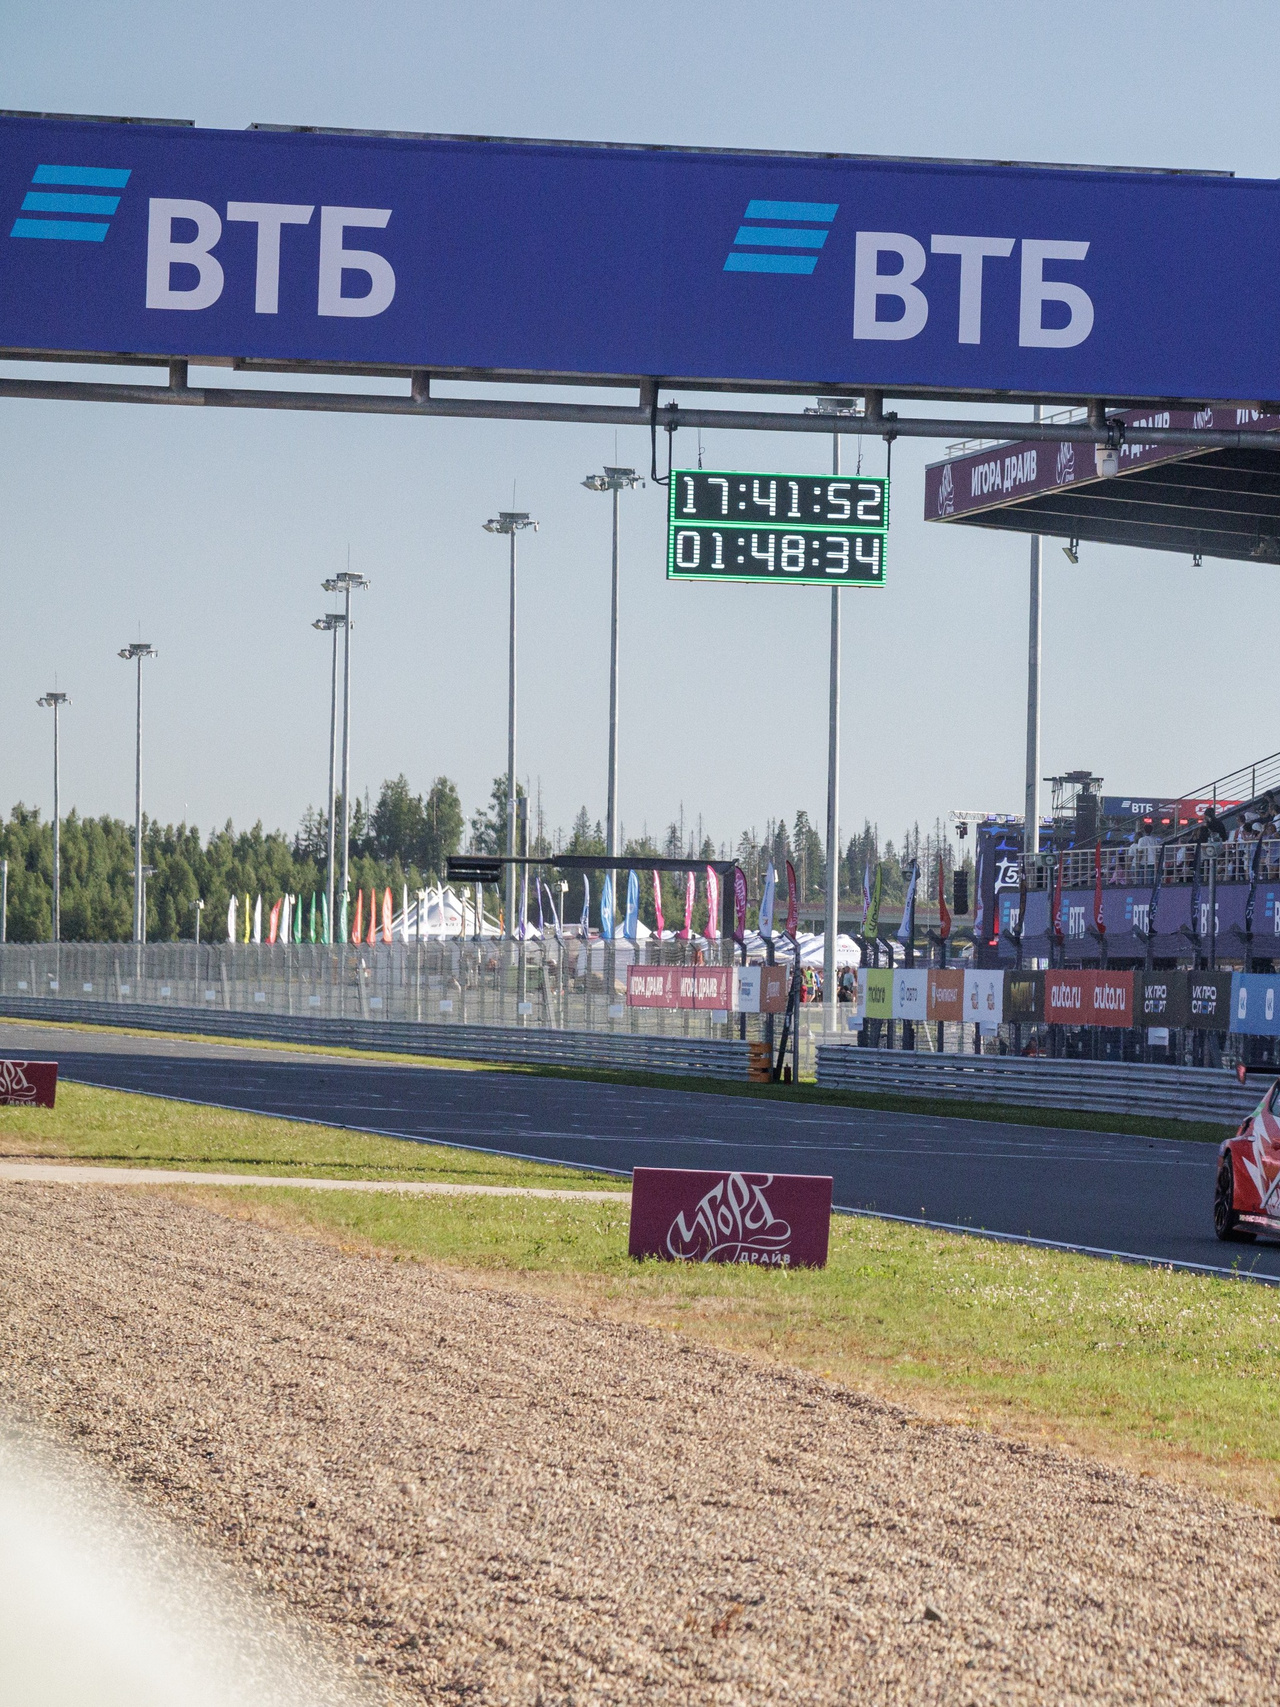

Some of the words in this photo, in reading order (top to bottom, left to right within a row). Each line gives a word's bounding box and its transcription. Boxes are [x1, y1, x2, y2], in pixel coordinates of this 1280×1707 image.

[145, 198, 397, 318] ВТБ
[853, 231, 1095, 349] ВТБ
[971, 459, 1001, 497] ИГОРА
[1003, 450, 1037, 493] ДРАЙВ
[682, 476, 881, 520] 17:41:52
[676, 530, 880, 575] 01:48:34
[1131, 803, 1153, 814] ВТБ
[1051, 982, 1081, 1008] auto.ru
[1093, 983, 1126, 1010] auto.ru
